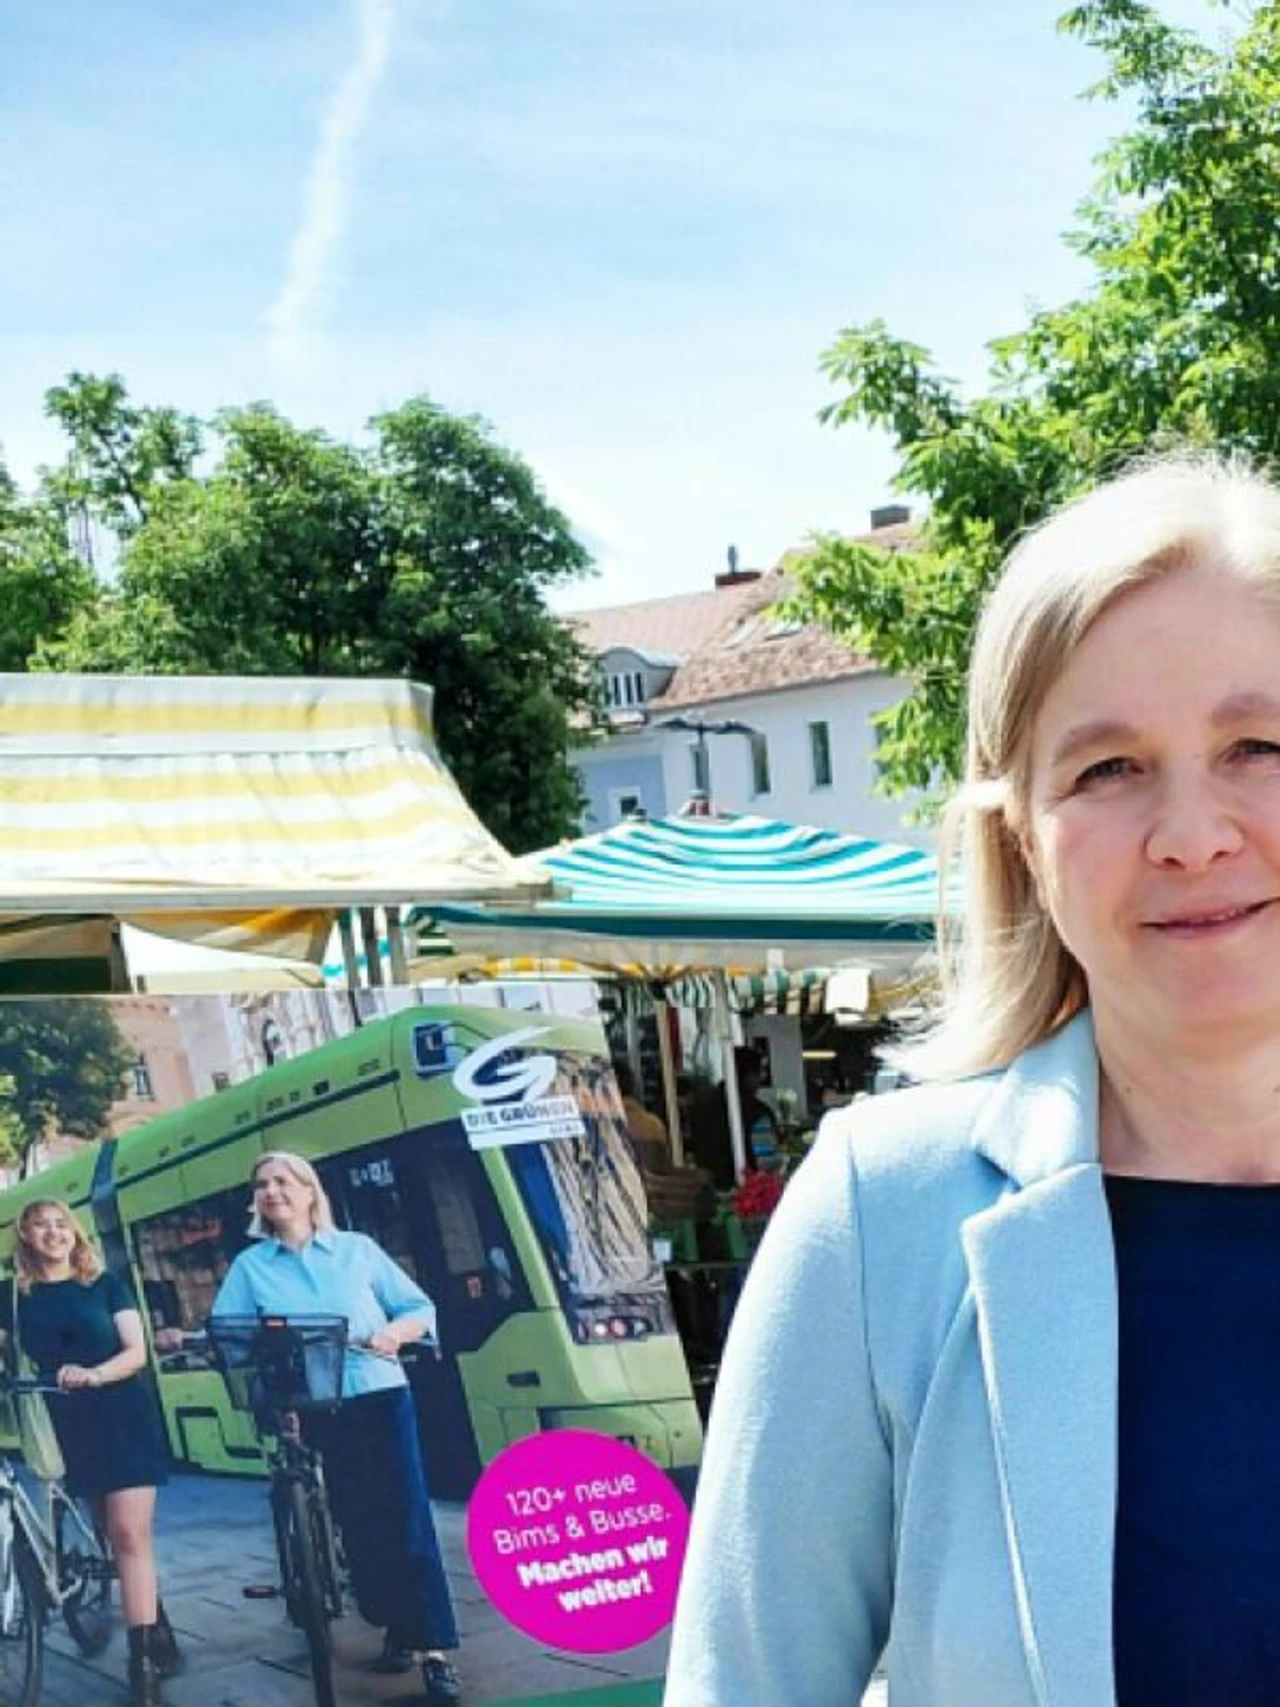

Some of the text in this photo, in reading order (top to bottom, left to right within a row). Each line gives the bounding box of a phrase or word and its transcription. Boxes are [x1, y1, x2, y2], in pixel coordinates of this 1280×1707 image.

[466, 1112, 498, 1126] DIE
[506, 1474, 637, 1516] 120+ neue
[493, 1503, 672, 1554] Bims & Busse.
[518, 1536, 669, 1588] Machen wir
[557, 1570, 653, 1612] weiter!
